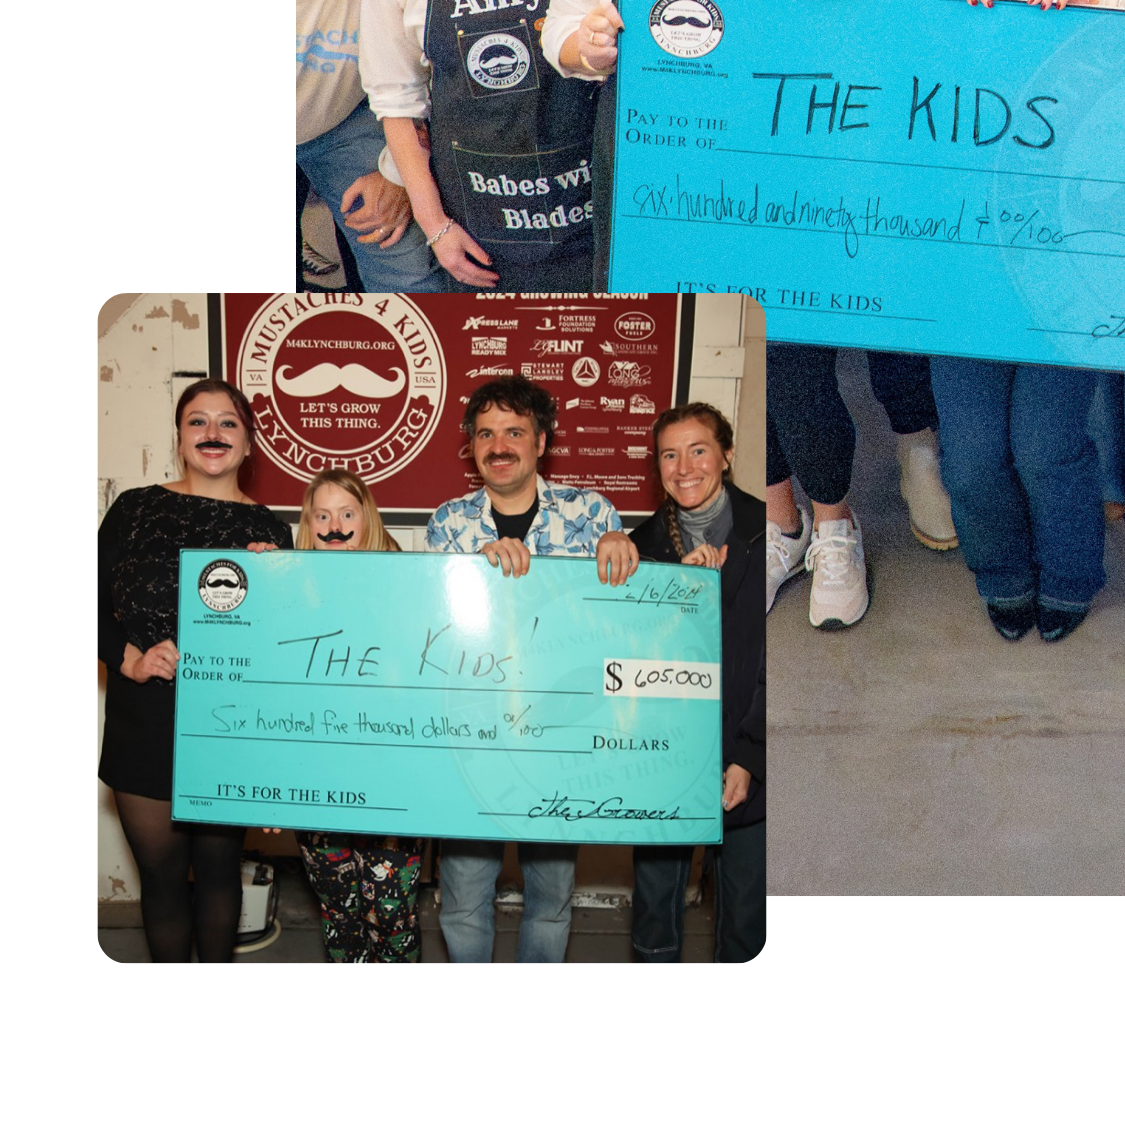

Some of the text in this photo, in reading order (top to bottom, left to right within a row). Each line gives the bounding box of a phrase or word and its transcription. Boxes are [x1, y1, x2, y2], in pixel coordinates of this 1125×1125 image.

[706, 2, 720, 20] KIDS
[627, 108, 728, 131] PAY TO THE
[752, 72, 882, 137] THE
[908, 75, 1058, 150] KIDS
[626, 129, 717, 150] ORDER OF
[468, 159, 592, 196] Babes wi
[501, 200, 593, 229] Blades
[677, 174, 758, 223] hundred
[860, 197, 965, 241] thousand
[777, 289, 821, 307] THE
[830, 293, 882, 312] KIDS
[251, 293, 432, 369] MUSTACHES 4 KIDS
[618, 321, 651, 331] FOSTER
[286, 339, 395, 350] M4KLYNCHBURG.ORG
[472, 340, 507, 350] LYNCHBURG
[548, 340, 584, 352] FLINT
[479, 365, 513, 376] intercon
[299, 402, 381, 414] LET'S GROW
[600, 397, 625, 407] Ryan
[300, 417, 381, 429] THIS THING.
[254, 405, 429, 475] LYNCHBURG
[681, 606, 699, 614] DATE
[183, 652, 251, 667] PAY TO THE
[277, 629, 381, 679] THE
[182, 667, 243, 682] ORDER OF
[605, 661, 623, 694] $
[211, 704, 247, 733] Six
[256, 709, 314, 735] hundred
[321, 709, 349, 735] five
[353, 712, 414, 740] thousand
[421, 717, 471, 740] dollars
[478, 725, 497, 741] and
[592, 735, 670, 752] DOLLARS
[189, 799, 213, 807] MEMO
[217, 784, 367, 805] IT'S FOR THE KIDS
